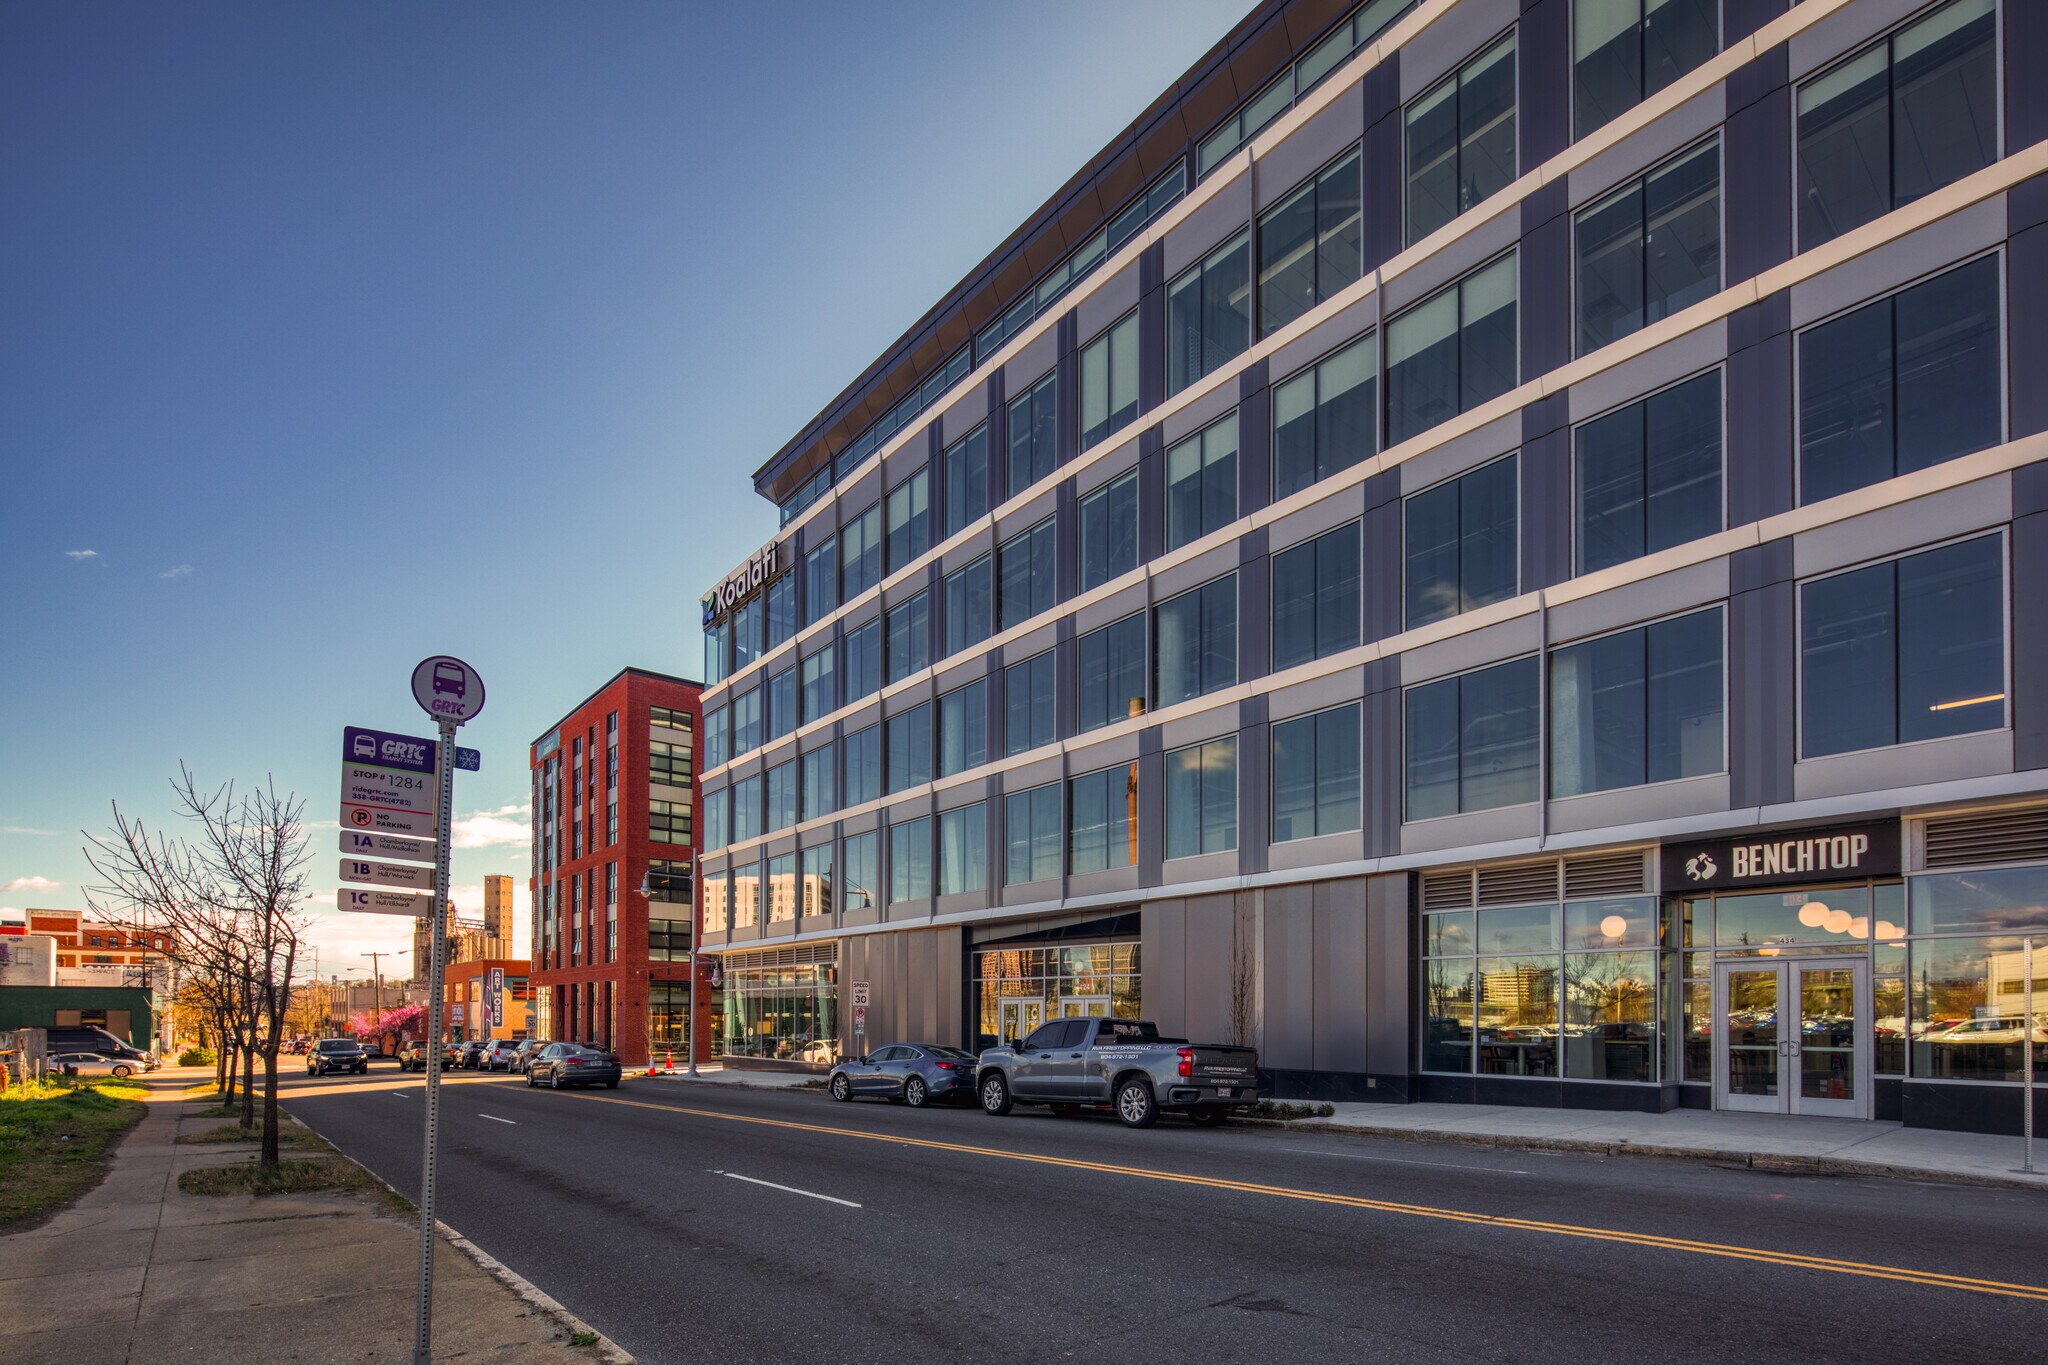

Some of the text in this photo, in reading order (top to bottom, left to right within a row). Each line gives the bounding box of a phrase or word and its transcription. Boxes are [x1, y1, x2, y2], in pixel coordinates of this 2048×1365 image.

[717, 541, 778, 614] Koalafi
[431, 698, 465, 715] GRTC
[381, 740, 426, 760] GRTC
[382, 755, 423, 766] TRANSIT SYSTEM
[353, 770, 378, 779] STOP
[389, 775, 423, 790] 1284
[352, 786, 399, 797] ridegrtc.com
[352, 793, 412, 807] 358-GRTC(4782)
[376, 820, 412, 830] PARKING
[353, 834, 373, 847] 1A
[1732, 834, 1868, 878] BENCHTOP
[352, 862, 370, 875] 1B
[350, 892, 369, 904] 1C
[855, 995, 867, 1004] 30
